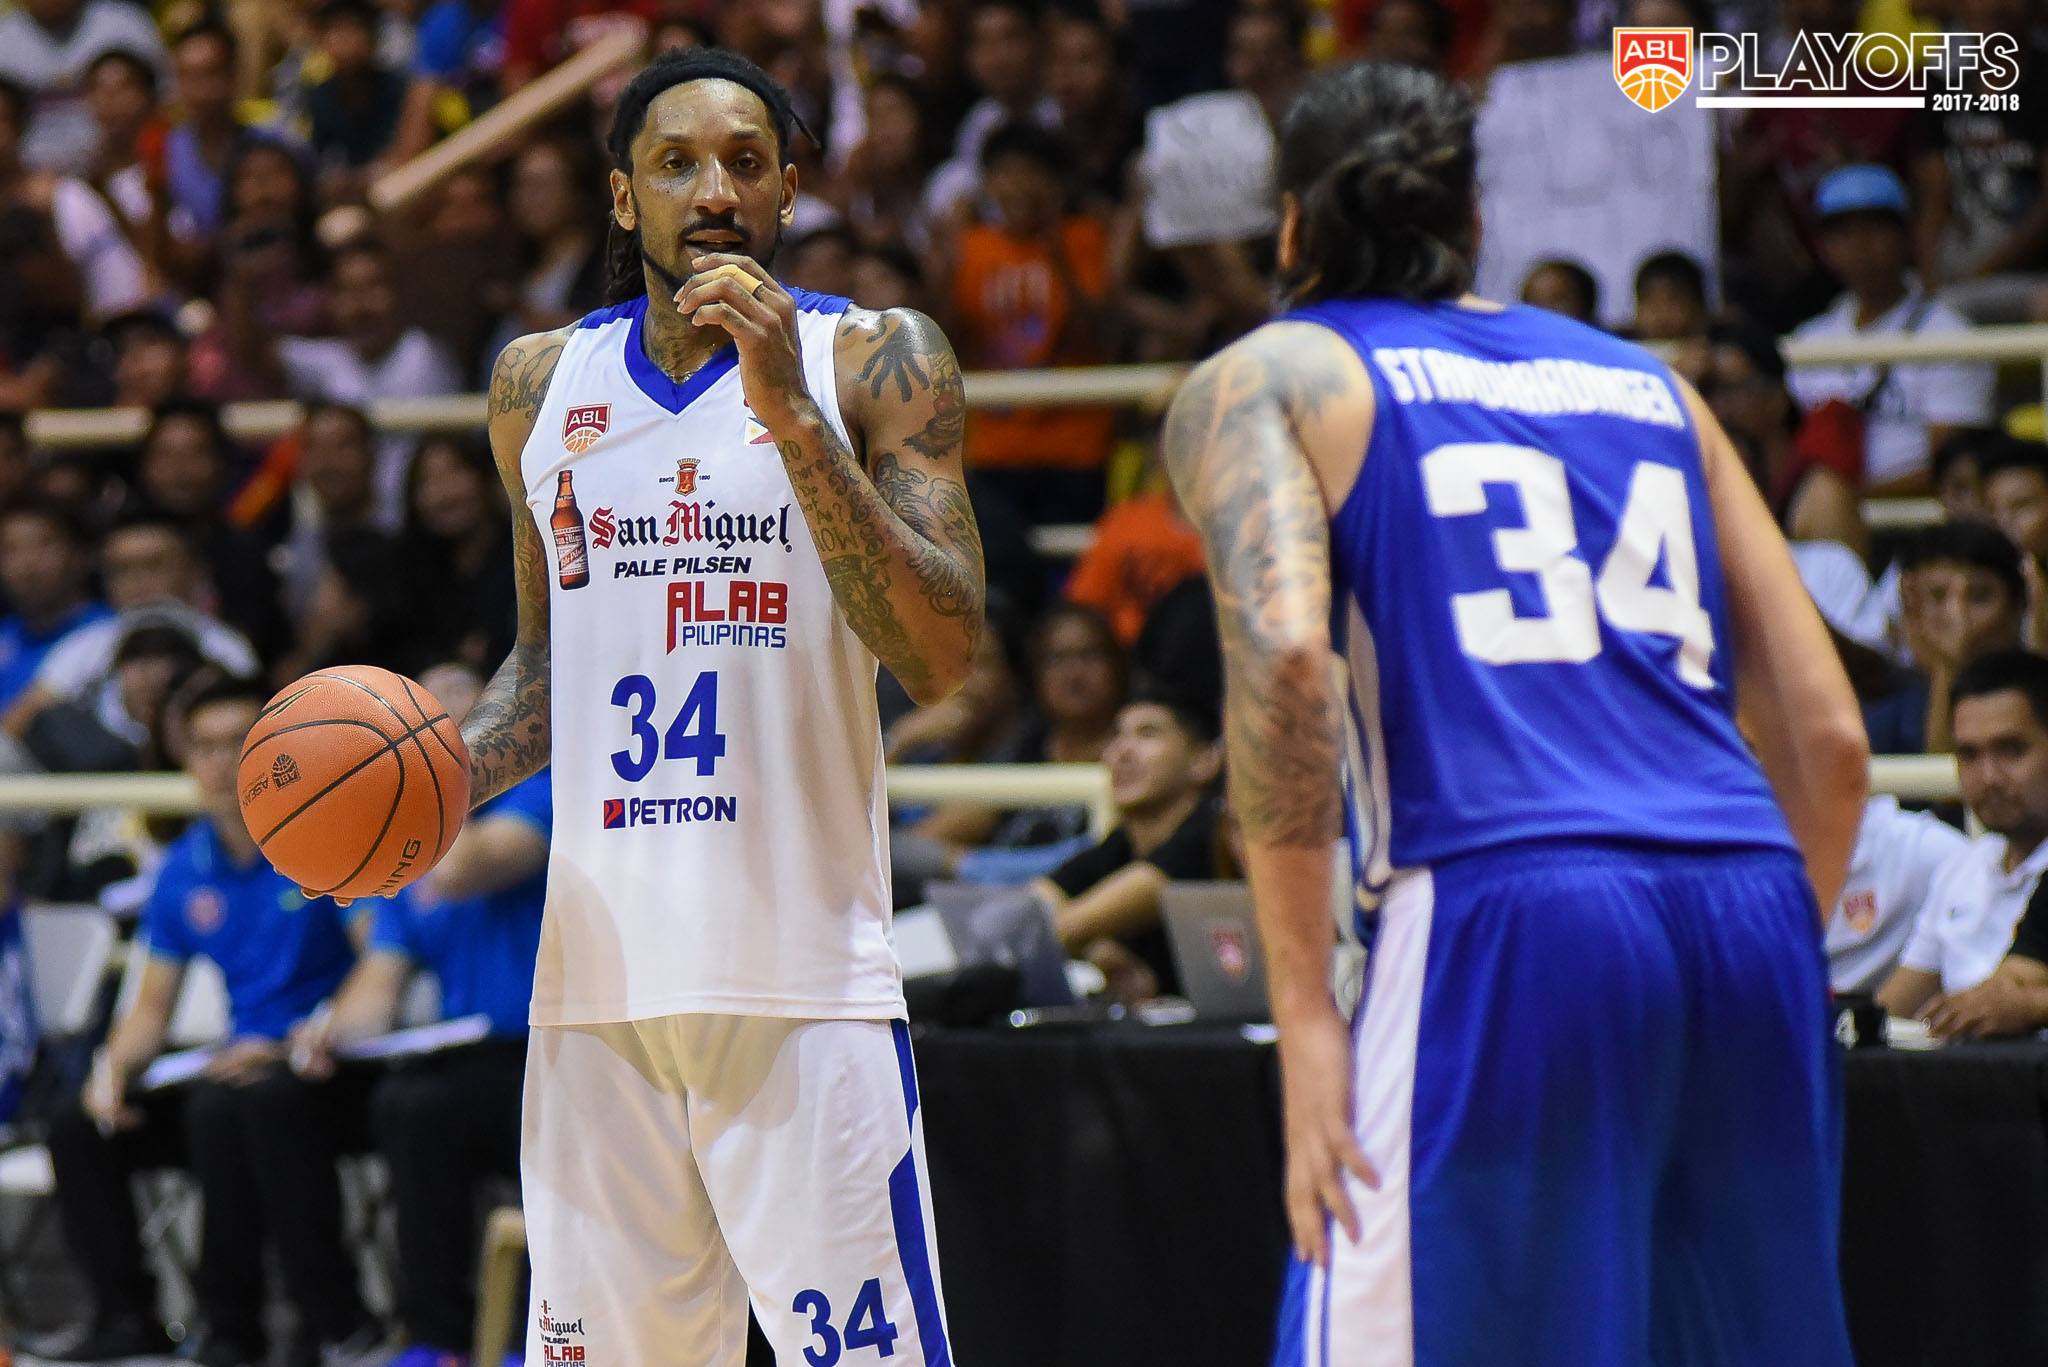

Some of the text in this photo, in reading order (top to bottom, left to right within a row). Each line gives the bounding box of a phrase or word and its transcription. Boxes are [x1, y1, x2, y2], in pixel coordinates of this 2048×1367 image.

[567, 410, 606, 429] ABL
[589, 499, 792, 551] San Miguel
[613, 556, 752, 579] PALE PILSEN
[1420, 442, 1715, 690] 34
[667, 580, 788, 655] ALAB
[682, 624, 787, 648] PILIPINAS
[610, 671, 726, 783] 34
[629, 796, 737, 827] PETRON
[791, 1276, 899, 1367] 34
[544, 1344, 586, 1367] ALAB
